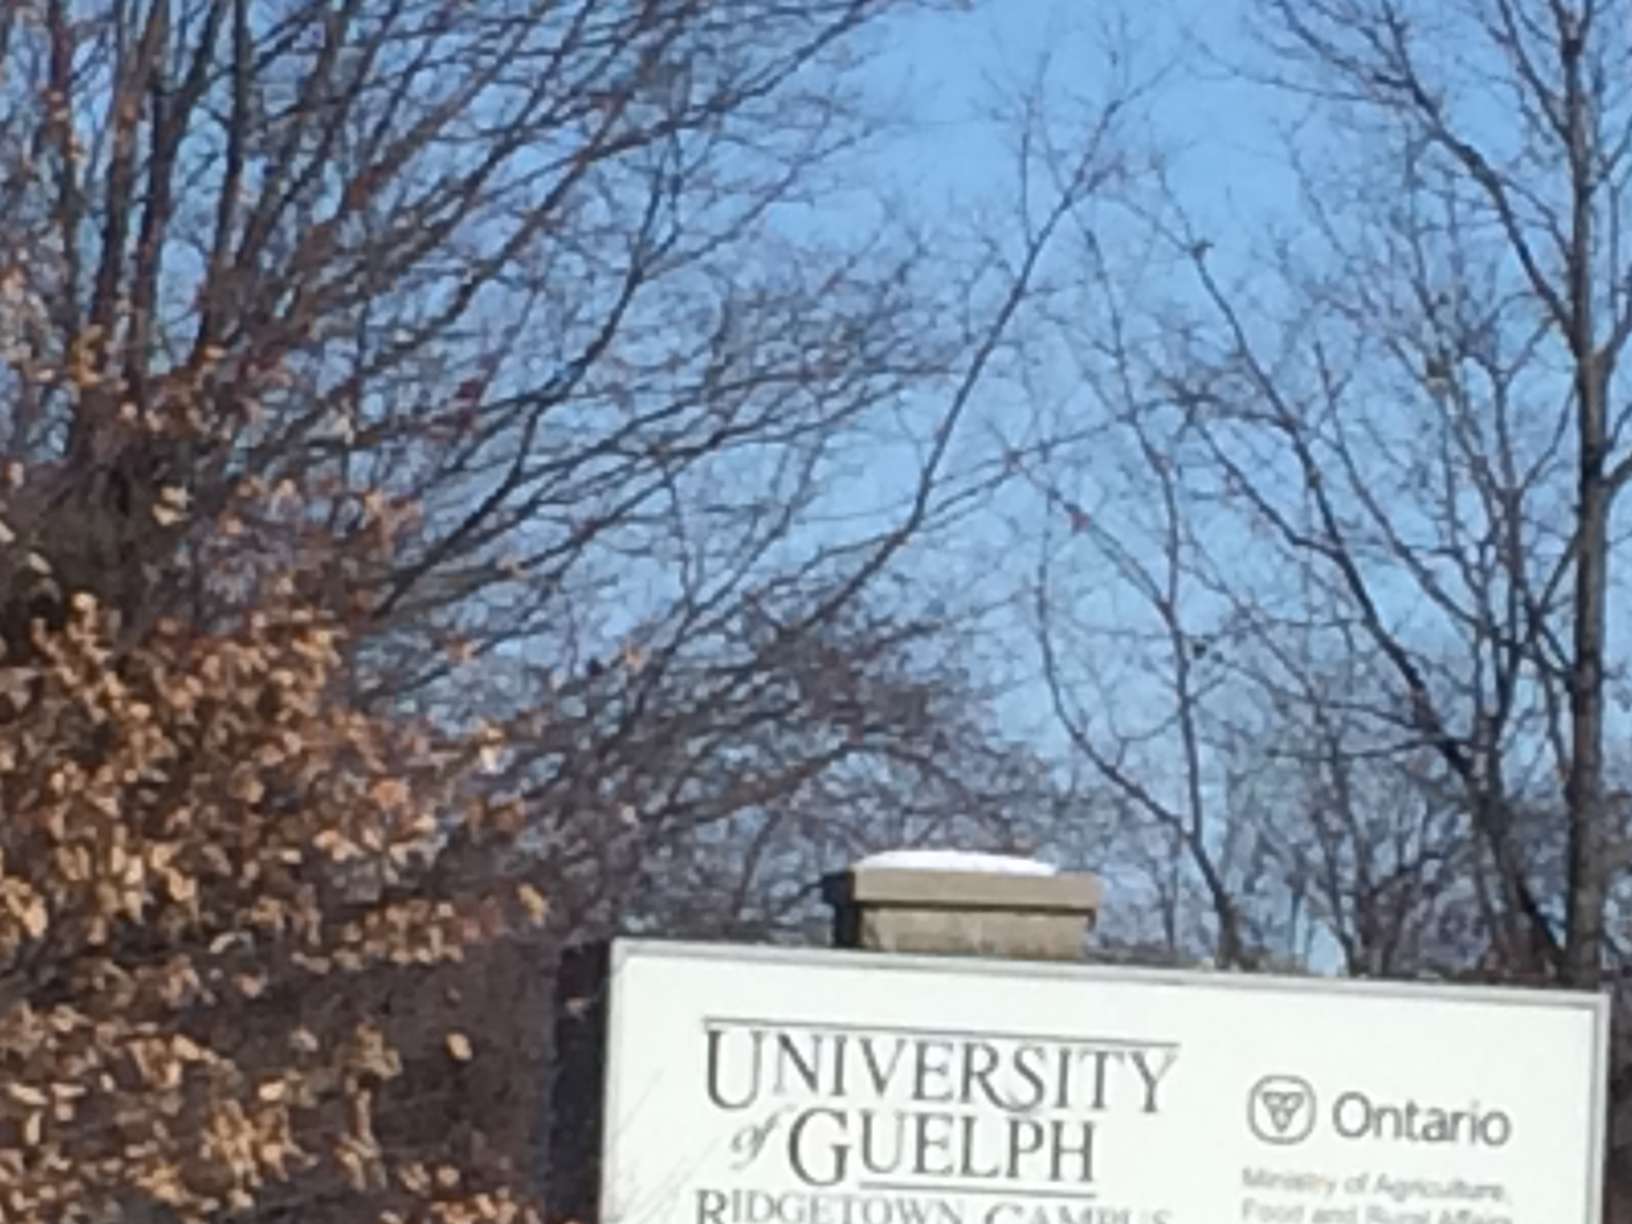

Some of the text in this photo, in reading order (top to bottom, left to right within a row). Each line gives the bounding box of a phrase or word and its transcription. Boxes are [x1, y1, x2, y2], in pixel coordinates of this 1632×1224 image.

[705, 1029, 1179, 1114] UNIVERSITY
[787, 1106, 1097, 1187] GUELPH
[1332, 1091, 1512, 1147] Ontario
[1241, 1166, 1336, 1196] Ministry
[1344, 1172, 1370, 1195] of
[1241, 1198, 1305, 1224] Food
